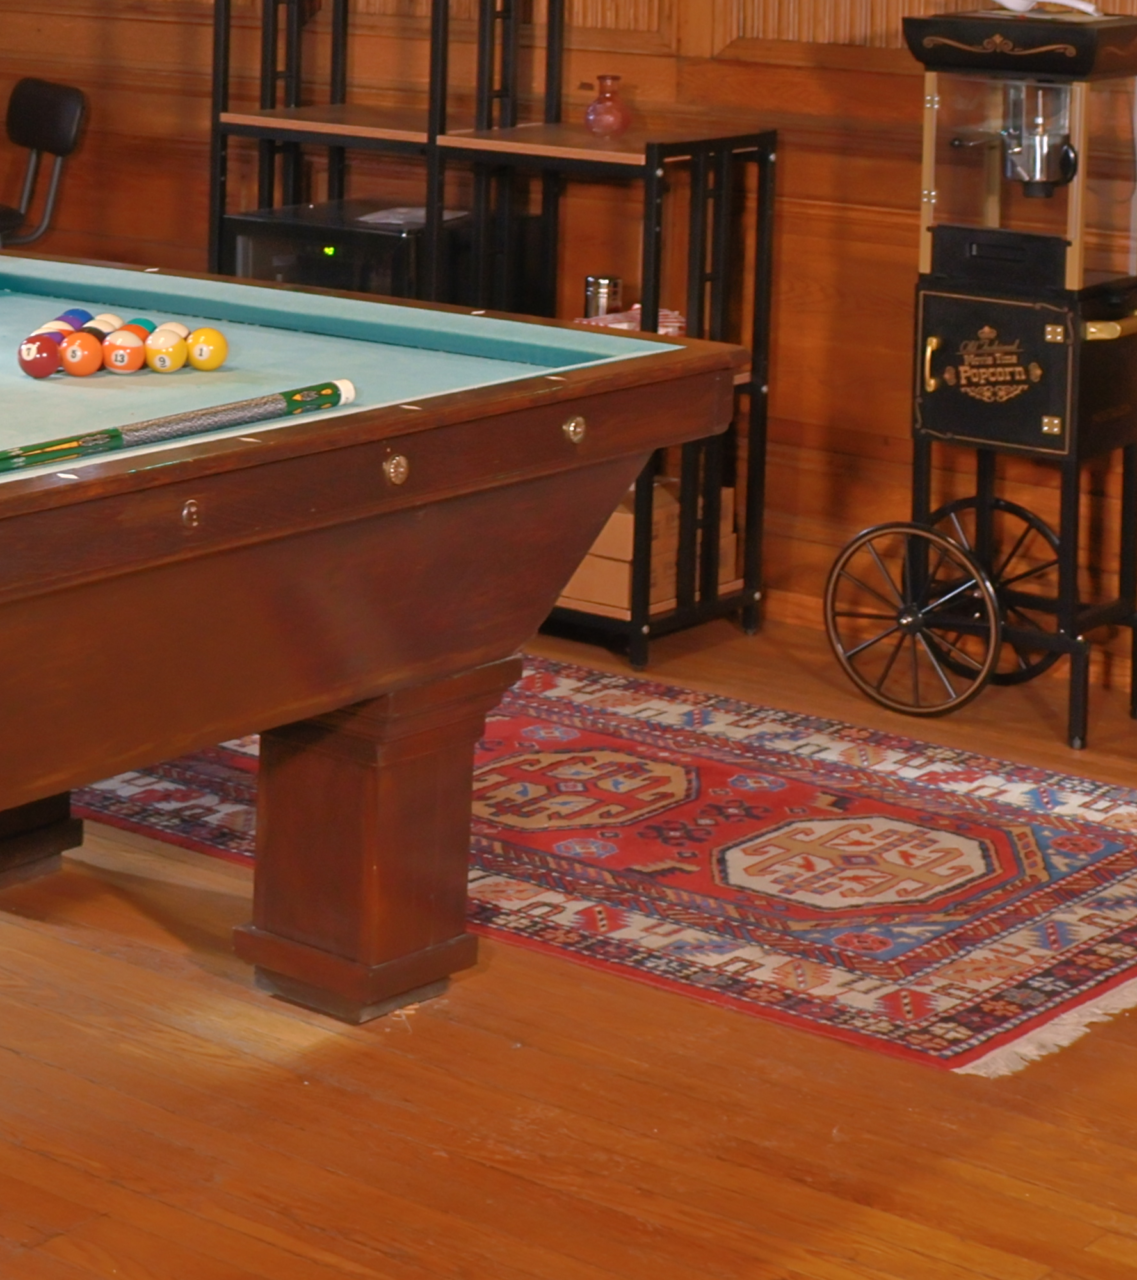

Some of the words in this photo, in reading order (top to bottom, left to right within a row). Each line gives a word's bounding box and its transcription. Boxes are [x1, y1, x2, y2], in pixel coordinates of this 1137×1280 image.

[26, 347, 32, 357] 7
[70, 349, 78, 359] 5
[198, 347, 204, 357] 1
[114, 353, 126, 364] 13
[158, 356, 167, 368] 9
[958, 365, 1027, 385] Popcorn
